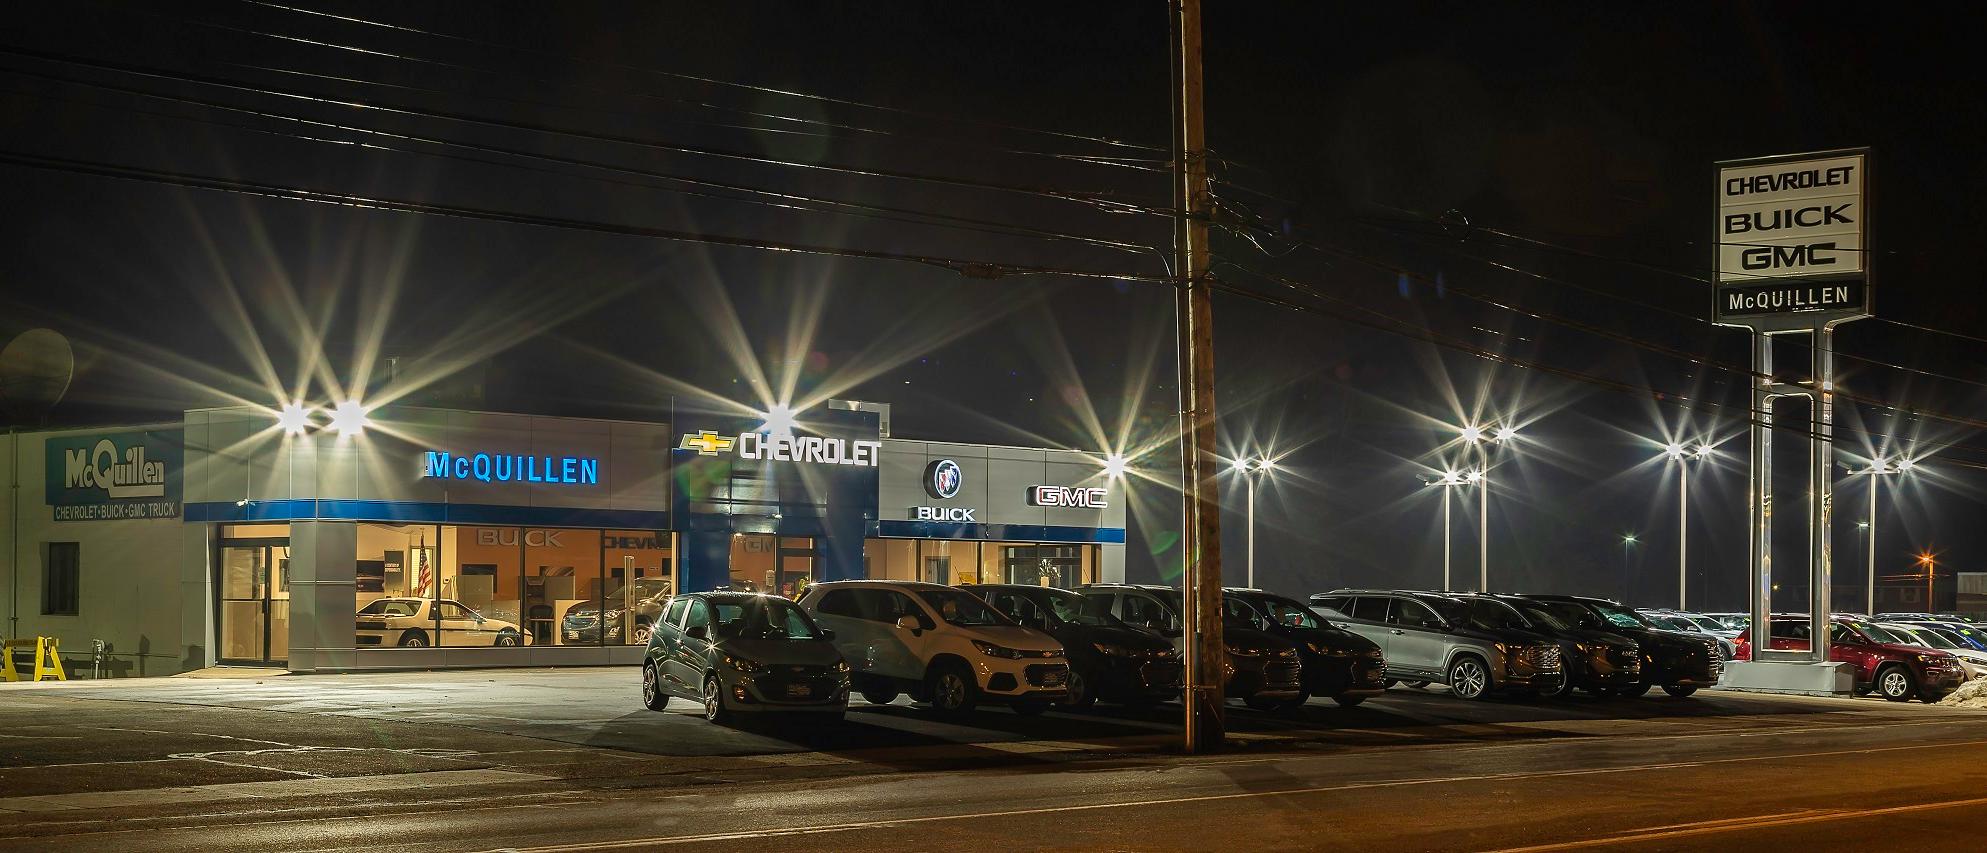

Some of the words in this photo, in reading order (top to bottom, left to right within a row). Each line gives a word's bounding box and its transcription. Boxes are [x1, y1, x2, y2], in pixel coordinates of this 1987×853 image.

[1726, 166, 1854, 196] CHEVROLET
[1725, 203, 1854, 235] BUICK
[1742, 242, 1836, 270] GMC
[1729, 286, 1848, 310] McQUILLEN
[739, 432, 882, 467] CHEVROLET
[65, 439, 164, 498] McQuillen
[425, 451, 598, 485] McQUILLEN
[148, 502, 175, 517] TRUCK
[1036, 485, 1109, 508] GMC
[917, 506, 976, 522] BUICK
[476, 528, 564, 549] BUCK
